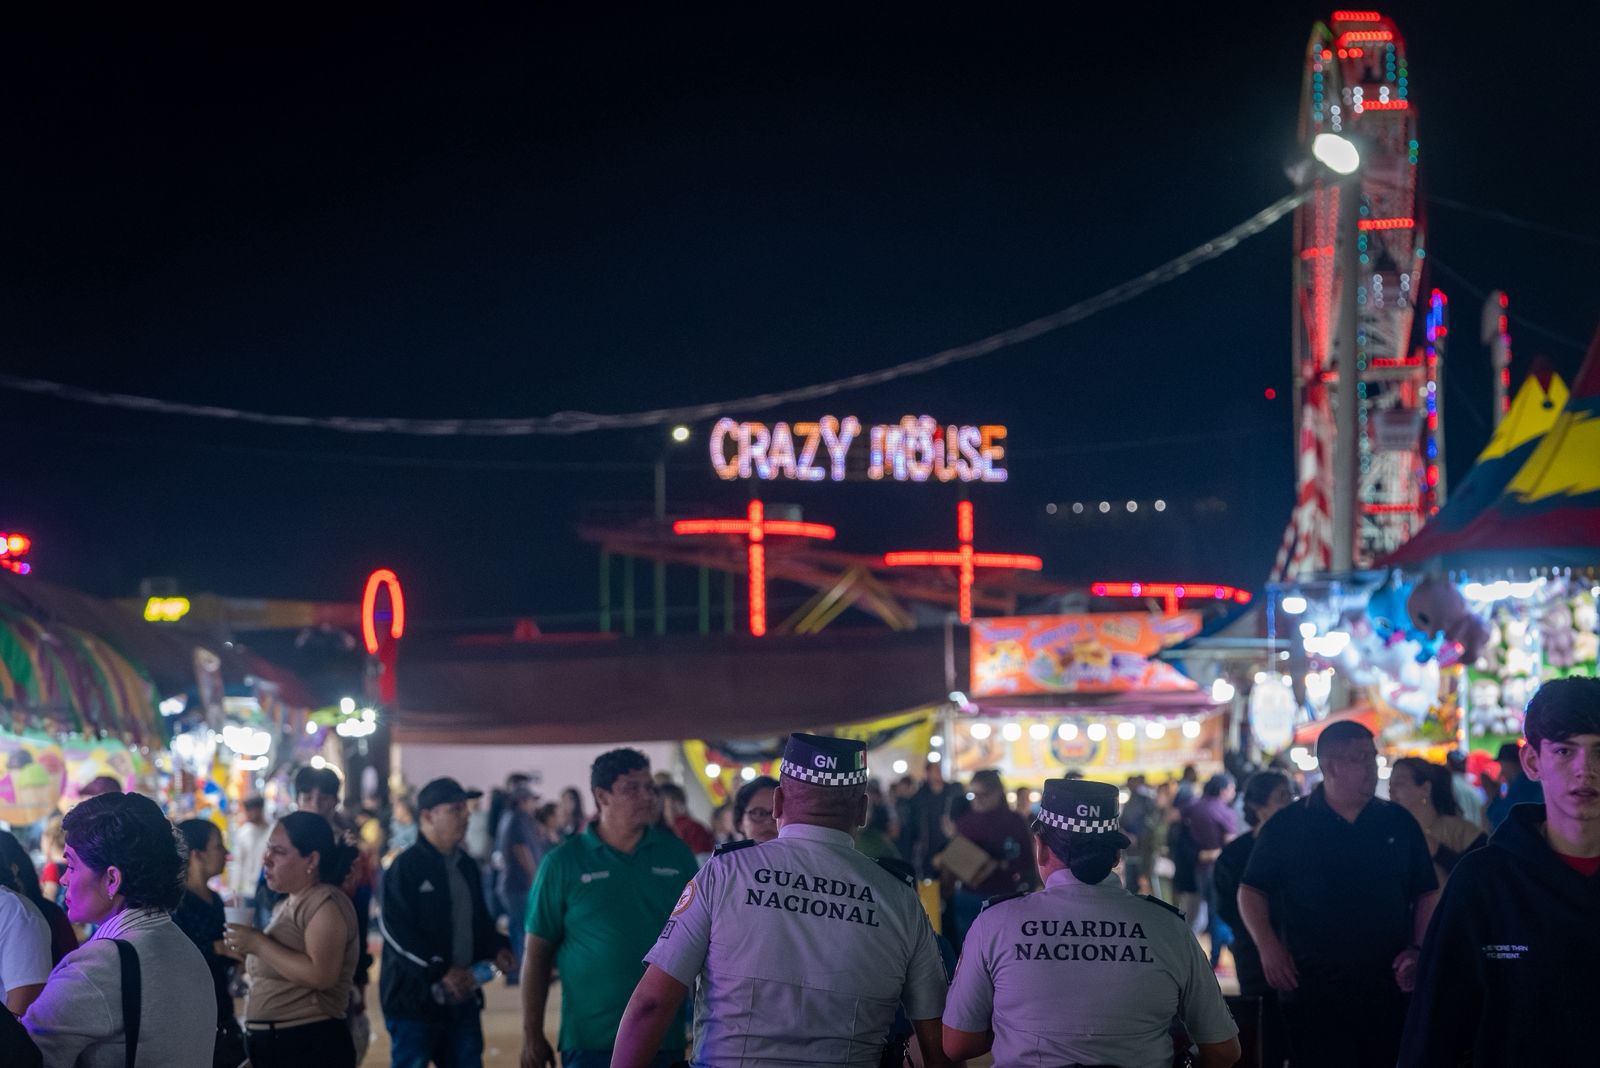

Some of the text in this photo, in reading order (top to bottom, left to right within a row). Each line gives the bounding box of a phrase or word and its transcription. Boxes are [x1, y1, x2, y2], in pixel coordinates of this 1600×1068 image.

[709, 414, 1008, 482] CRAZY MOUSE
[814, 754, 838, 770] GN
[1076, 804, 1101, 818] GN
[754, 868, 876, 904] GUARDIA
[745, 888, 880, 928] NACIONAL
[1021, 920, 1148, 940] GUARDIA
[1015, 943, 1154, 963] NACIONAL
